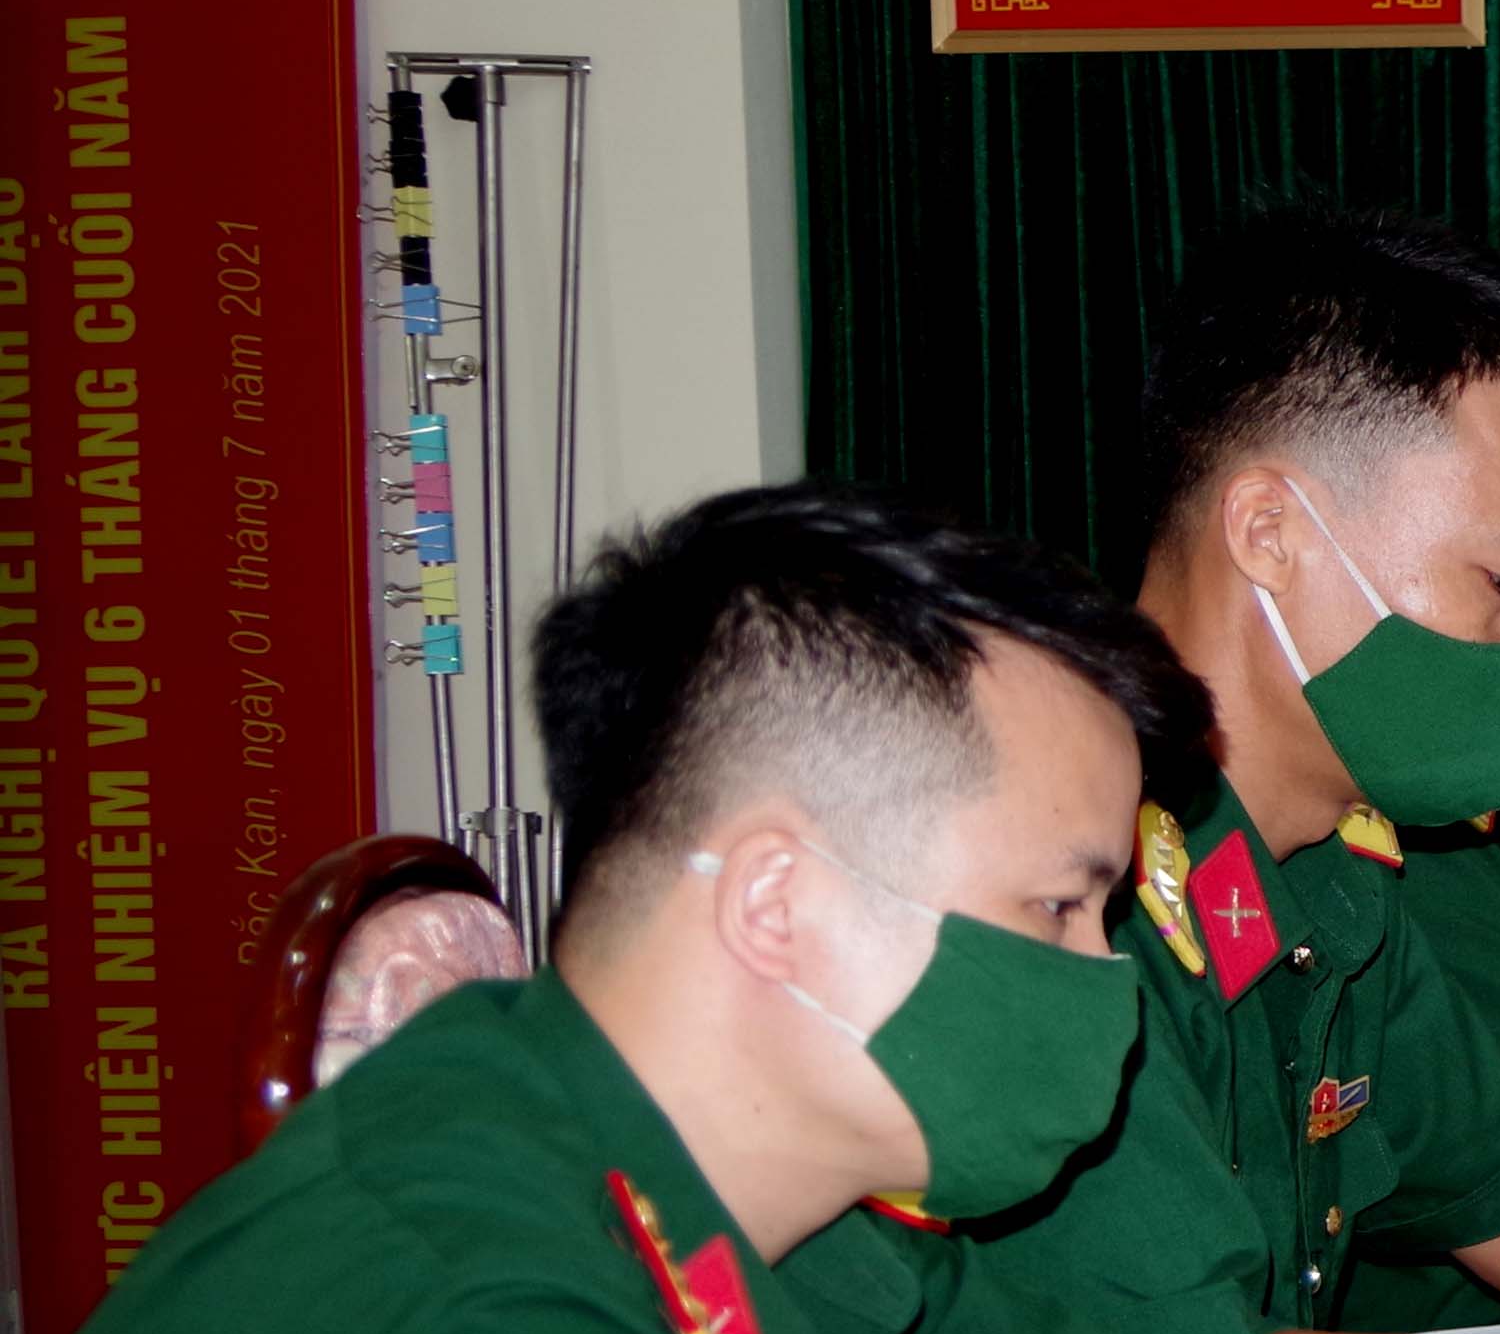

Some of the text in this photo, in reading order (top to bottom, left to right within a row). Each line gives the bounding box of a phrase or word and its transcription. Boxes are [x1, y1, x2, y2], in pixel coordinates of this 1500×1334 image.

[53, 14, 131, 167] NĂM
[48, 190, 136, 342] CUỐI
[215, 217, 264, 315] 2021
[220, 331, 267, 421] năm
[64, 366, 143, 582] THÁNG
[222, 434, 268, 457] 7
[222, 475, 279, 591] tháng
[85, 604, 145, 642] 6
[227, 606, 273, 654] 01
[85, 665, 161, 746] VỤ
[232, 670, 291, 768] ngày
[0, 747, 56, 903] NGHỊ
[234, 785, 288, 877] Kạn,
[76, 769, 166, 981] NHIỆM
[1, 923, 50, 1008] RA
[84, 1005, 174, 1155] HIỆN
